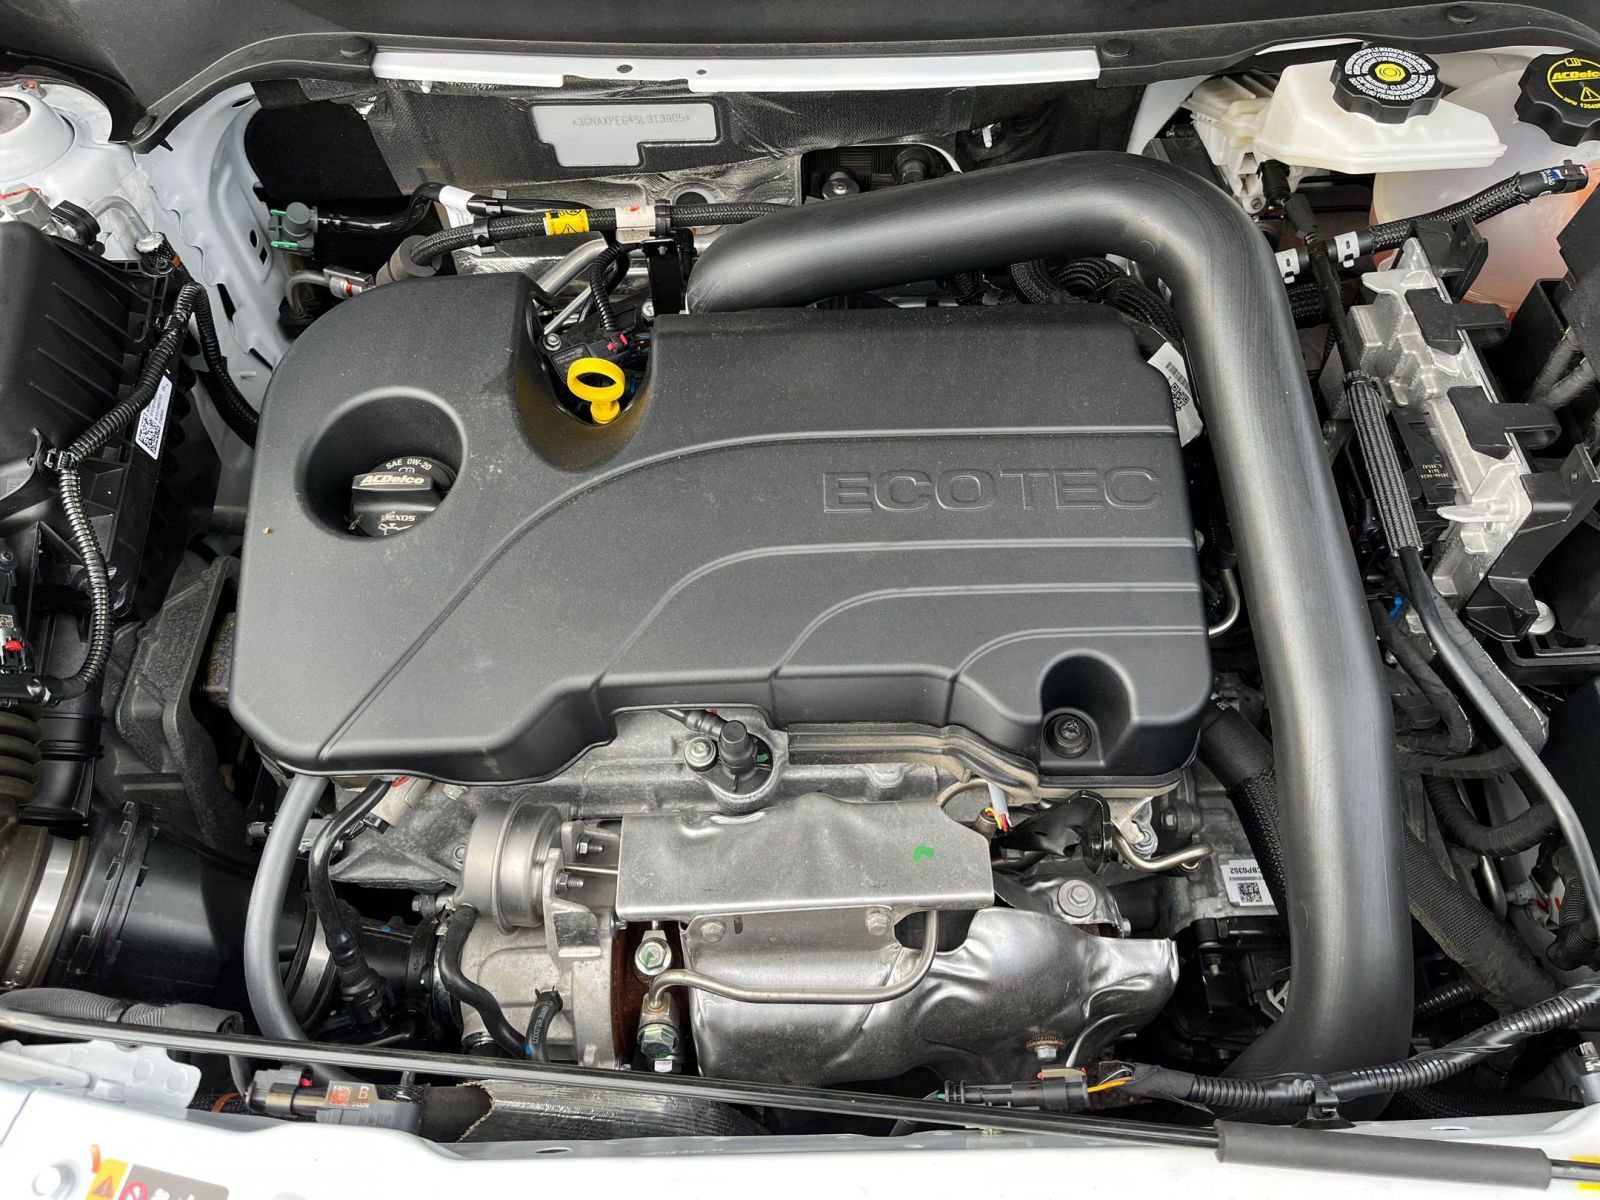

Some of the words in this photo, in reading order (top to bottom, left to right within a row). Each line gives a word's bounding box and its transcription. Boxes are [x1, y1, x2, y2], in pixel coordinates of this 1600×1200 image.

[386, 459, 402, 469] SAE
[407, 458, 432, 470] 0W-20
[360, 475, 424, 485] ACDelco
[822, 467, 1161, 513] ECOTEC
